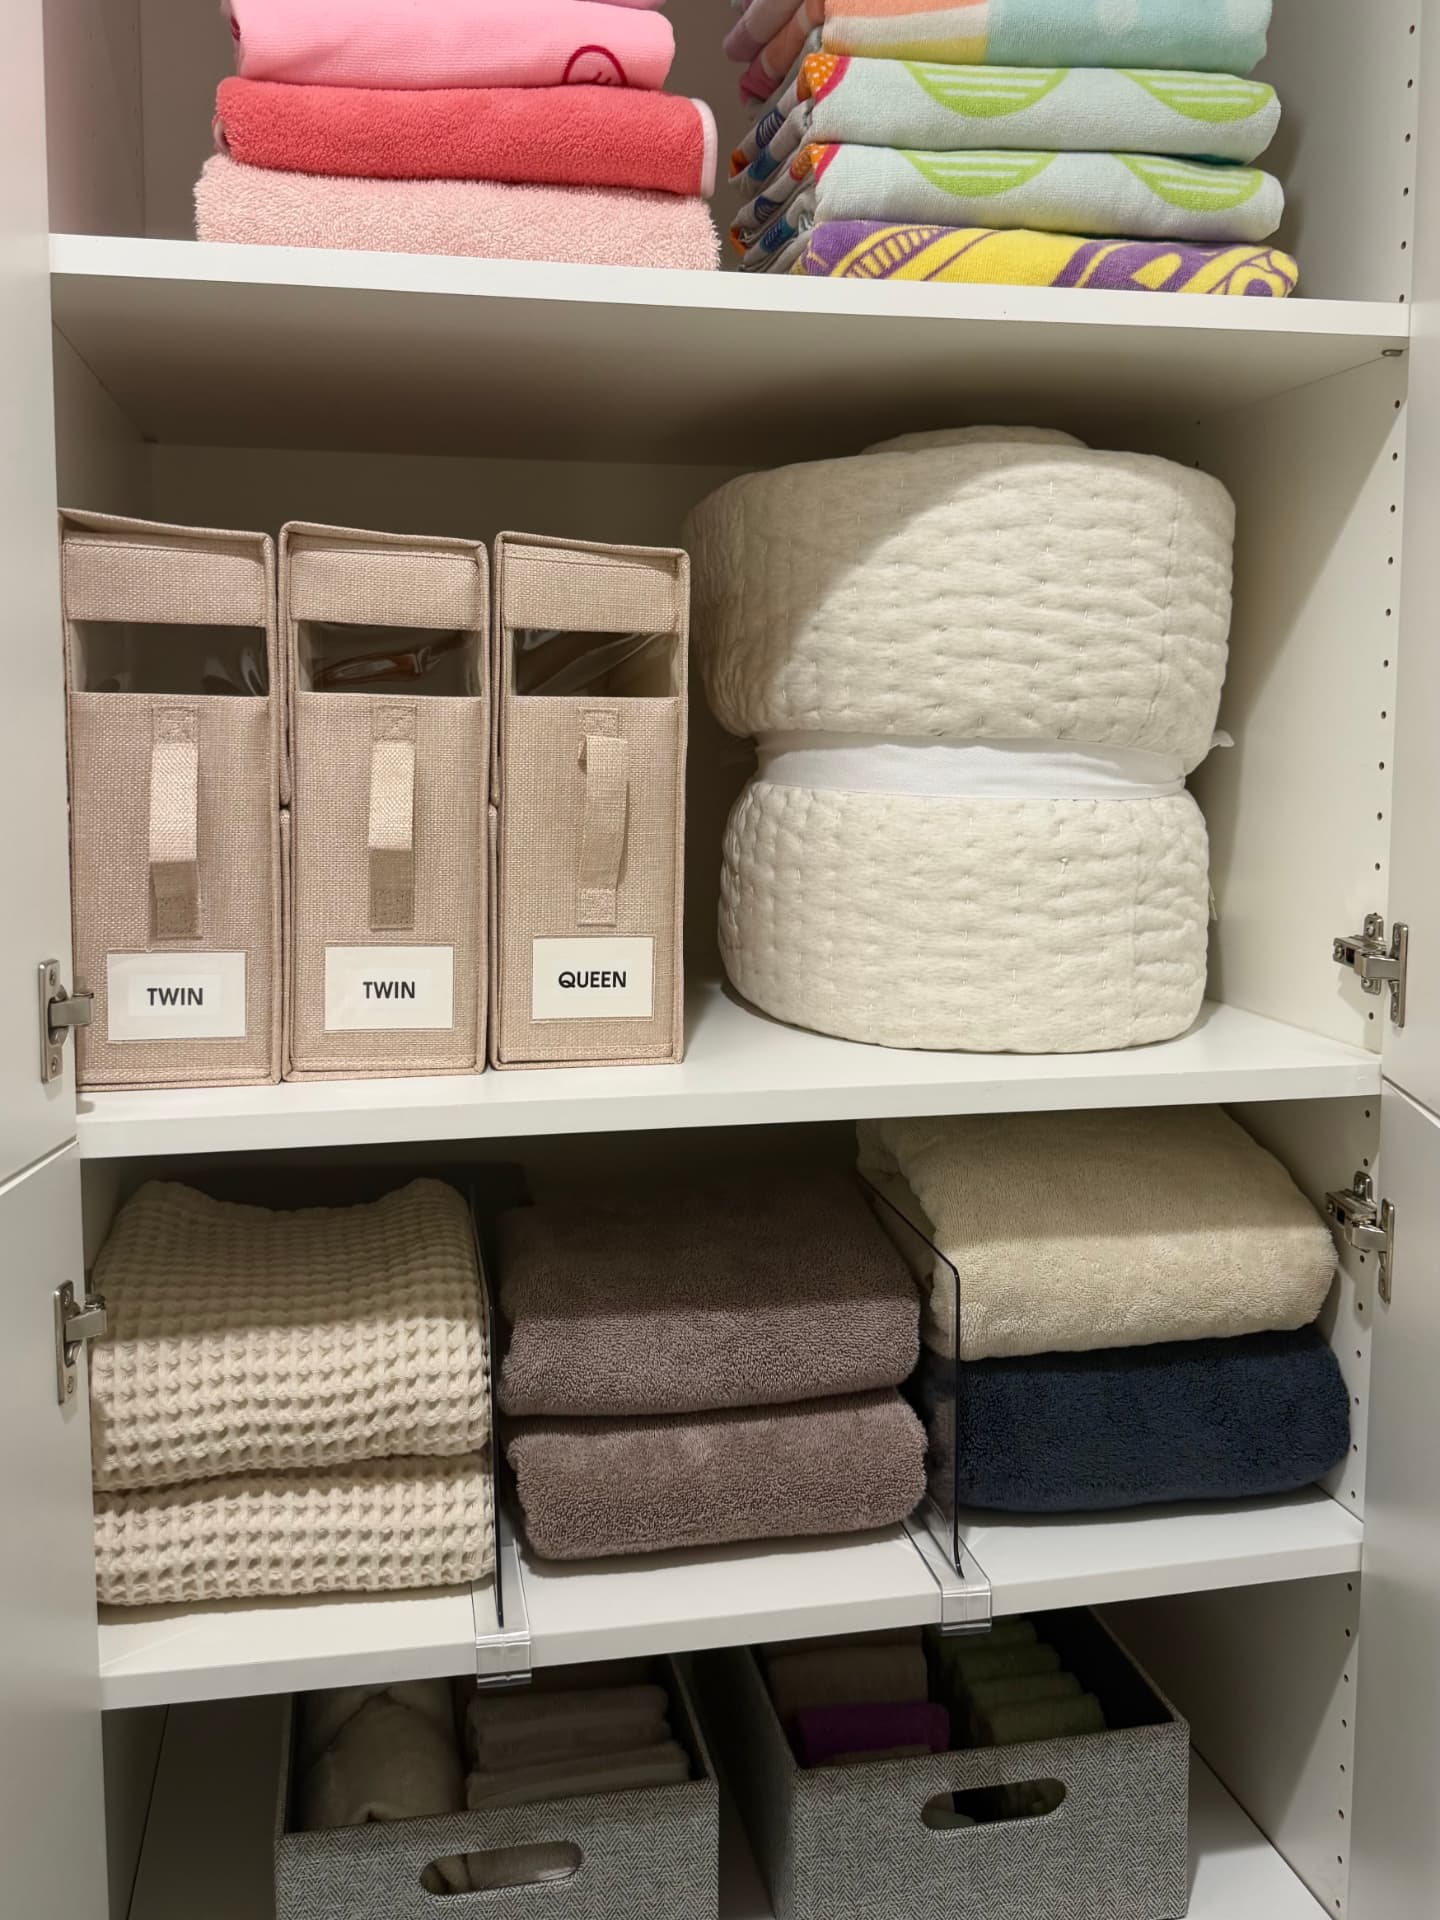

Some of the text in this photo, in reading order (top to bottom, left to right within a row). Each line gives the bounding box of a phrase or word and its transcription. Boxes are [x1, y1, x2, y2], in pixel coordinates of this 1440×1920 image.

[558, 970, 627, 989] QUEEN
[147, 987, 203, 1006] TWIN
[363, 981, 415, 999] TWIN
